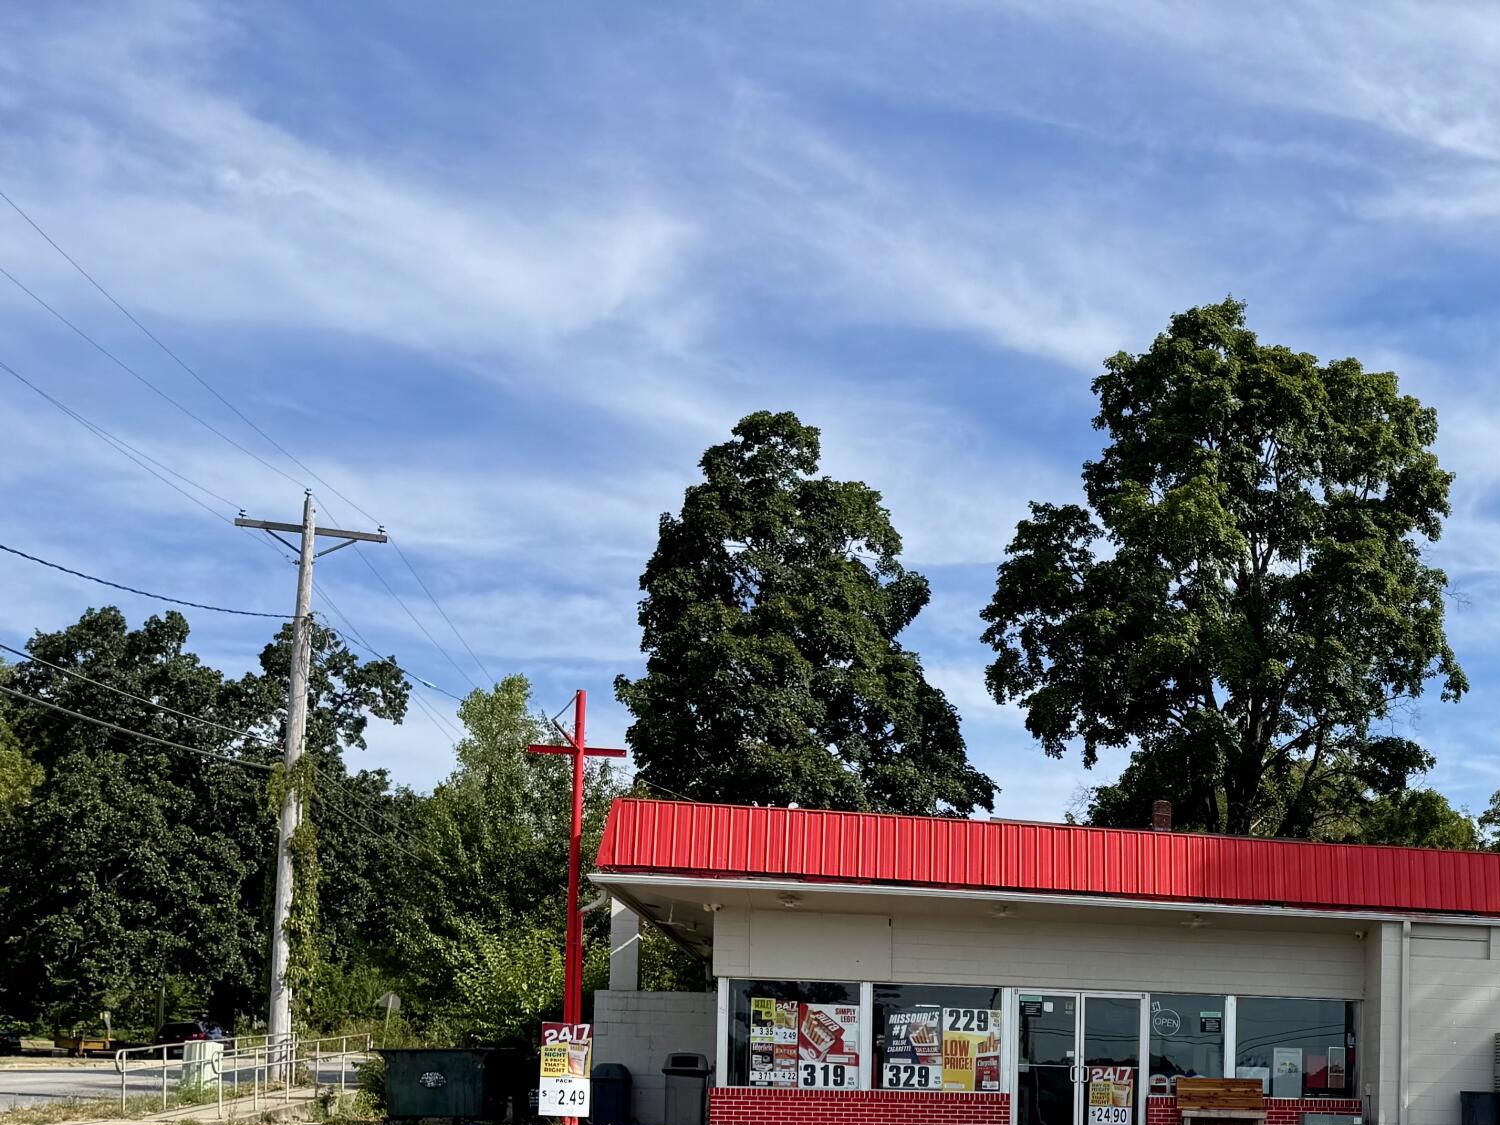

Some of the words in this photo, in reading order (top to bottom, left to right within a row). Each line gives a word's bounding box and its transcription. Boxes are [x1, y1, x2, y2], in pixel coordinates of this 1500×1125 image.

[889, 1012, 940, 1025] MISSOURI'S
[948, 1009, 989, 1032] 229
[1154, 1017, 1179, 1028] OPEN
[544, 1024, 591, 1046] 24/7
[892, 1025, 908, 1039] #1
[887, 1045, 912, 1053] CIGARETTE
[944, 1040, 970, 1057] LOW
[944, 1056, 973, 1071] PRICE!
[803, 1063, 846, 1087] 319
[888, 1065, 930, 1088] 329
[1091, 1066, 1132, 1083] 24/7
[558, 1089, 585, 1105] 2.49
[1097, 1107, 1127, 1123] 24.90
